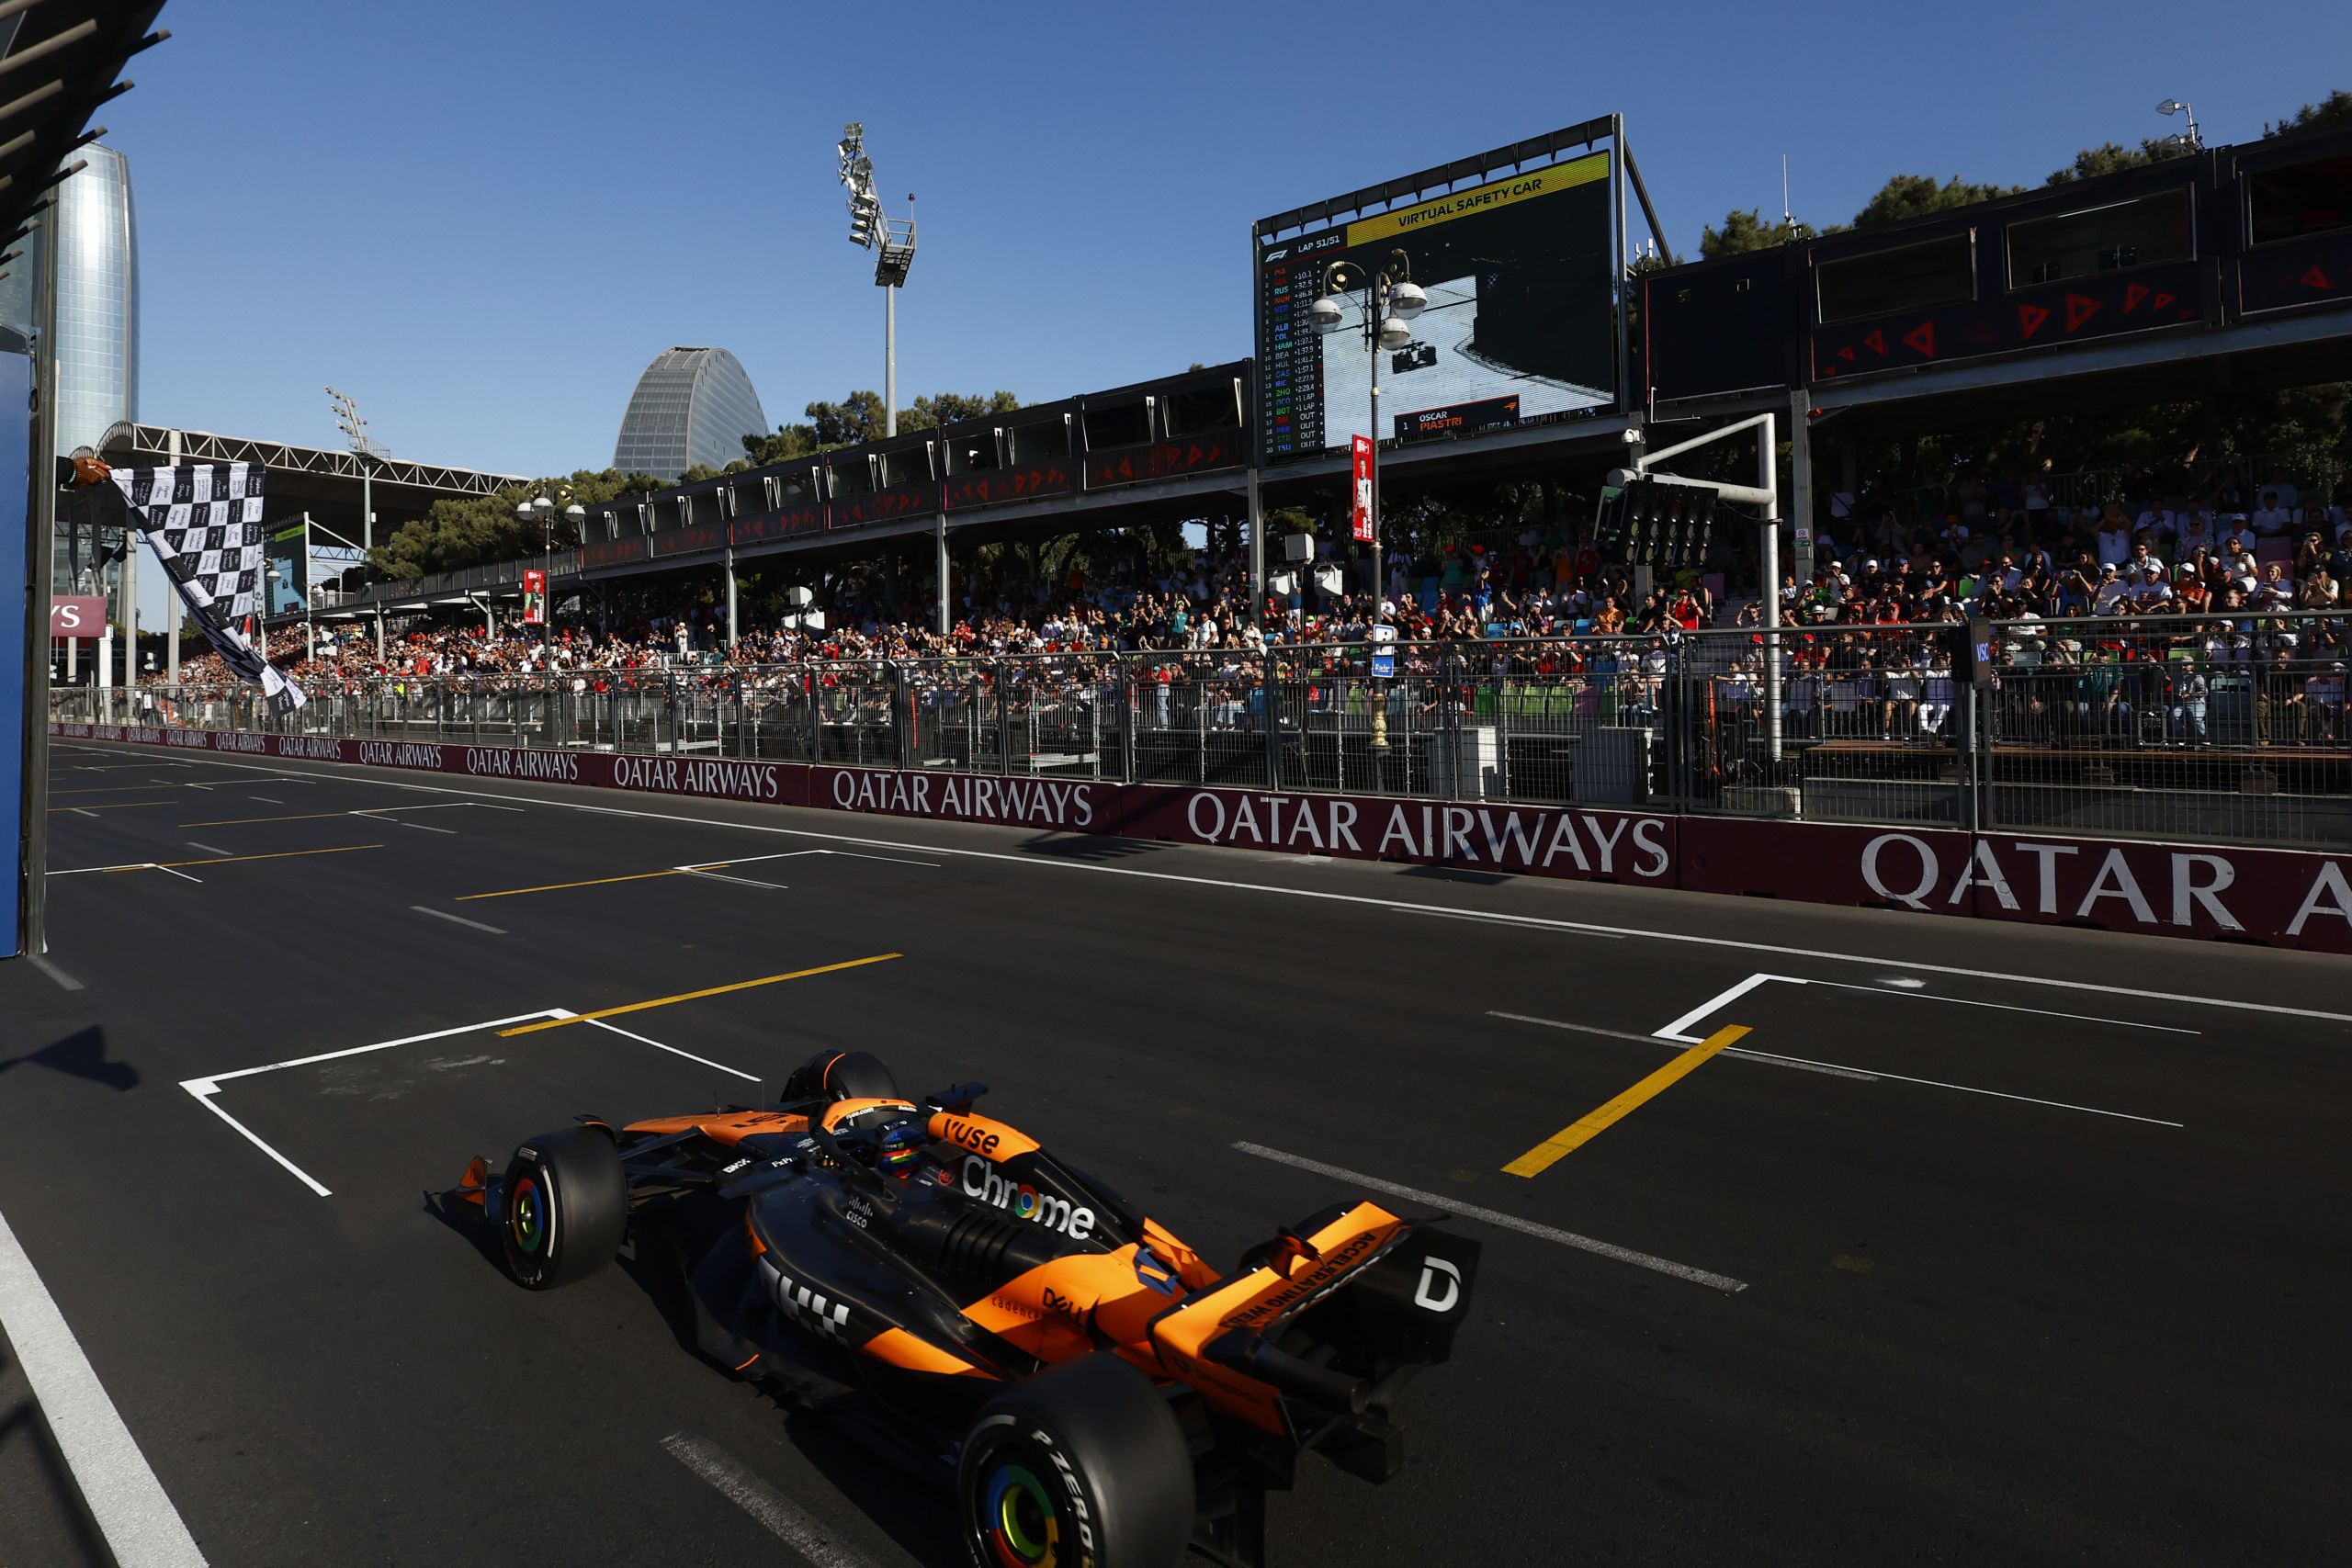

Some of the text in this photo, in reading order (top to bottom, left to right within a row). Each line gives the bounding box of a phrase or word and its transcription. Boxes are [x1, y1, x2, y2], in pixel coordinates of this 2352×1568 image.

[1398, 178, 1543, 227] VIRTUAL SAFETY CAR
[1298, 235, 1340, 254] LAP 51/51
[1275, 286, 1289, 295] RUS
[1295, 280, 1312, 288] +32.5
[1275, 323, 1289, 332] ALB
[1275, 341, 1293, 350] HAM
[1275, 351, 1289, 360] BEA
[1276, 369, 1290, 378] GAS
[1295, 365, 1314, 374] +1:57.1
[1295, 384, 1314, 393] +2:29.4
[1419, 411, 1448, 423] OSCAR
[1419, 416, 1463, 432] PIASTRI
[1977, 642, 1989, 662] VSC
[167, 728, 207, 747] QATAR AIRWAYS
[215, 733, 265, 753] QATAR AIRWAYS
[279, 736, 341, 759] QATAR AIRWAYS
[359, 741, 441, 768] QATAR AIRWAYS
[466, 747, 578, 780] QATAR AIRWAYS
[614, 757, 778, 798] QATAR AIRWAYS
[833, 770, 1093, 826] QATAR AIRWAYS
[1187, 792, 1670, 877] QATAR AIRWAYS
[1860, 833, 2247, 931] QATAR
[962, 1155, 1096, 1240] Chrome
[1043, 1286, 1085, 1327] DELL
[1031, 1429, 1095, 1551] P ZERO
